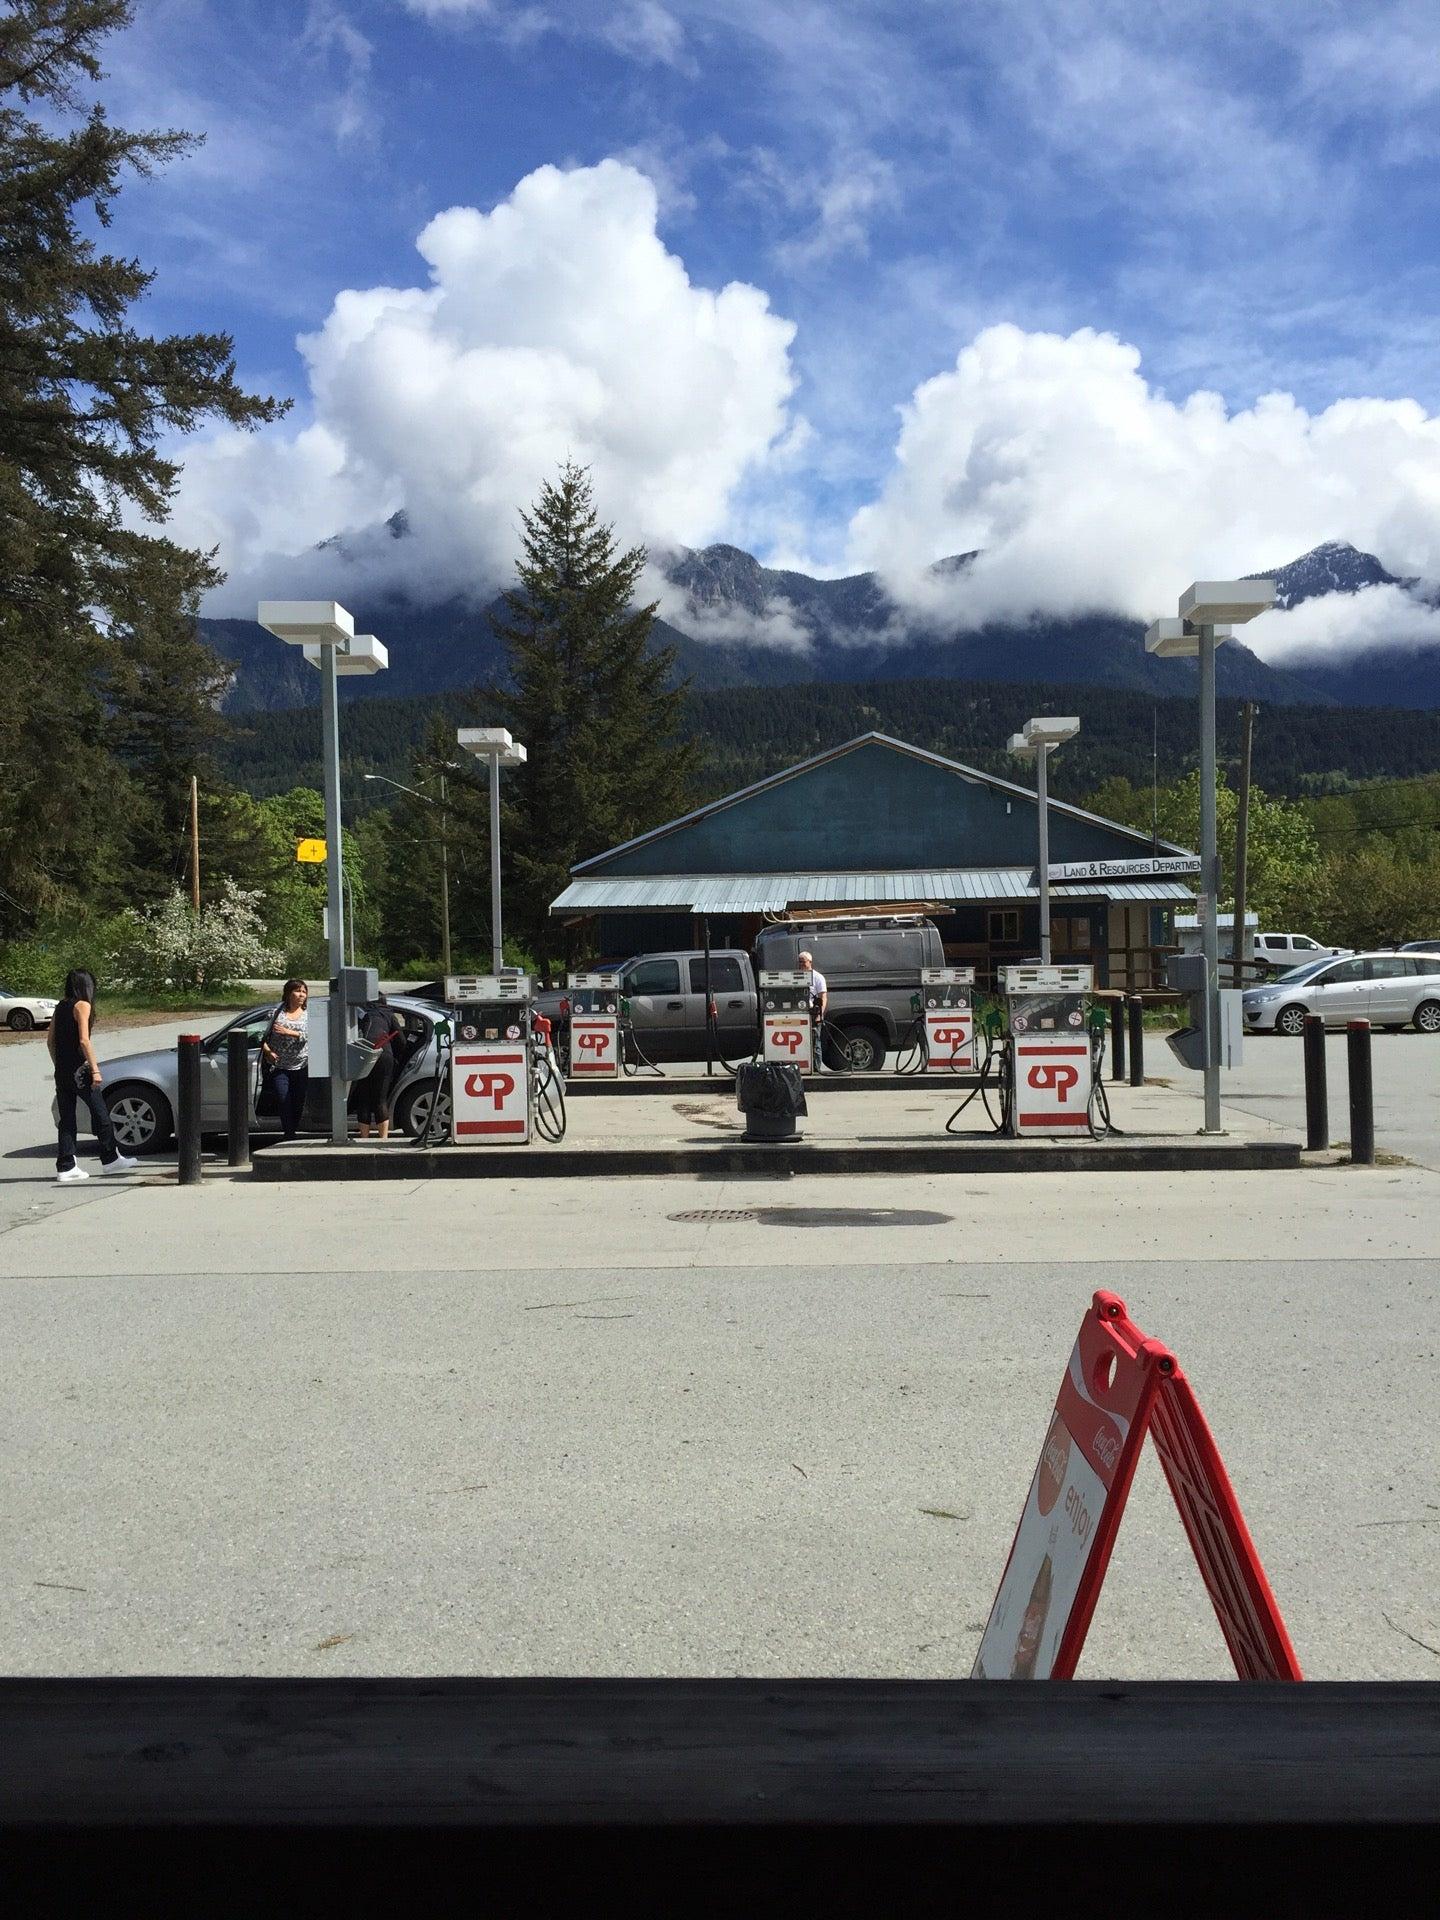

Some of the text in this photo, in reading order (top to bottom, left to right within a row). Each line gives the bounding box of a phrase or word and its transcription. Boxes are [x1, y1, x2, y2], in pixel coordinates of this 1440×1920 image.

[1089, 863, 1097, 876] &
[1152, 859, 1201, 872] DEPARTMEN
[1065, 1485, 1094, 1550] enjoy
